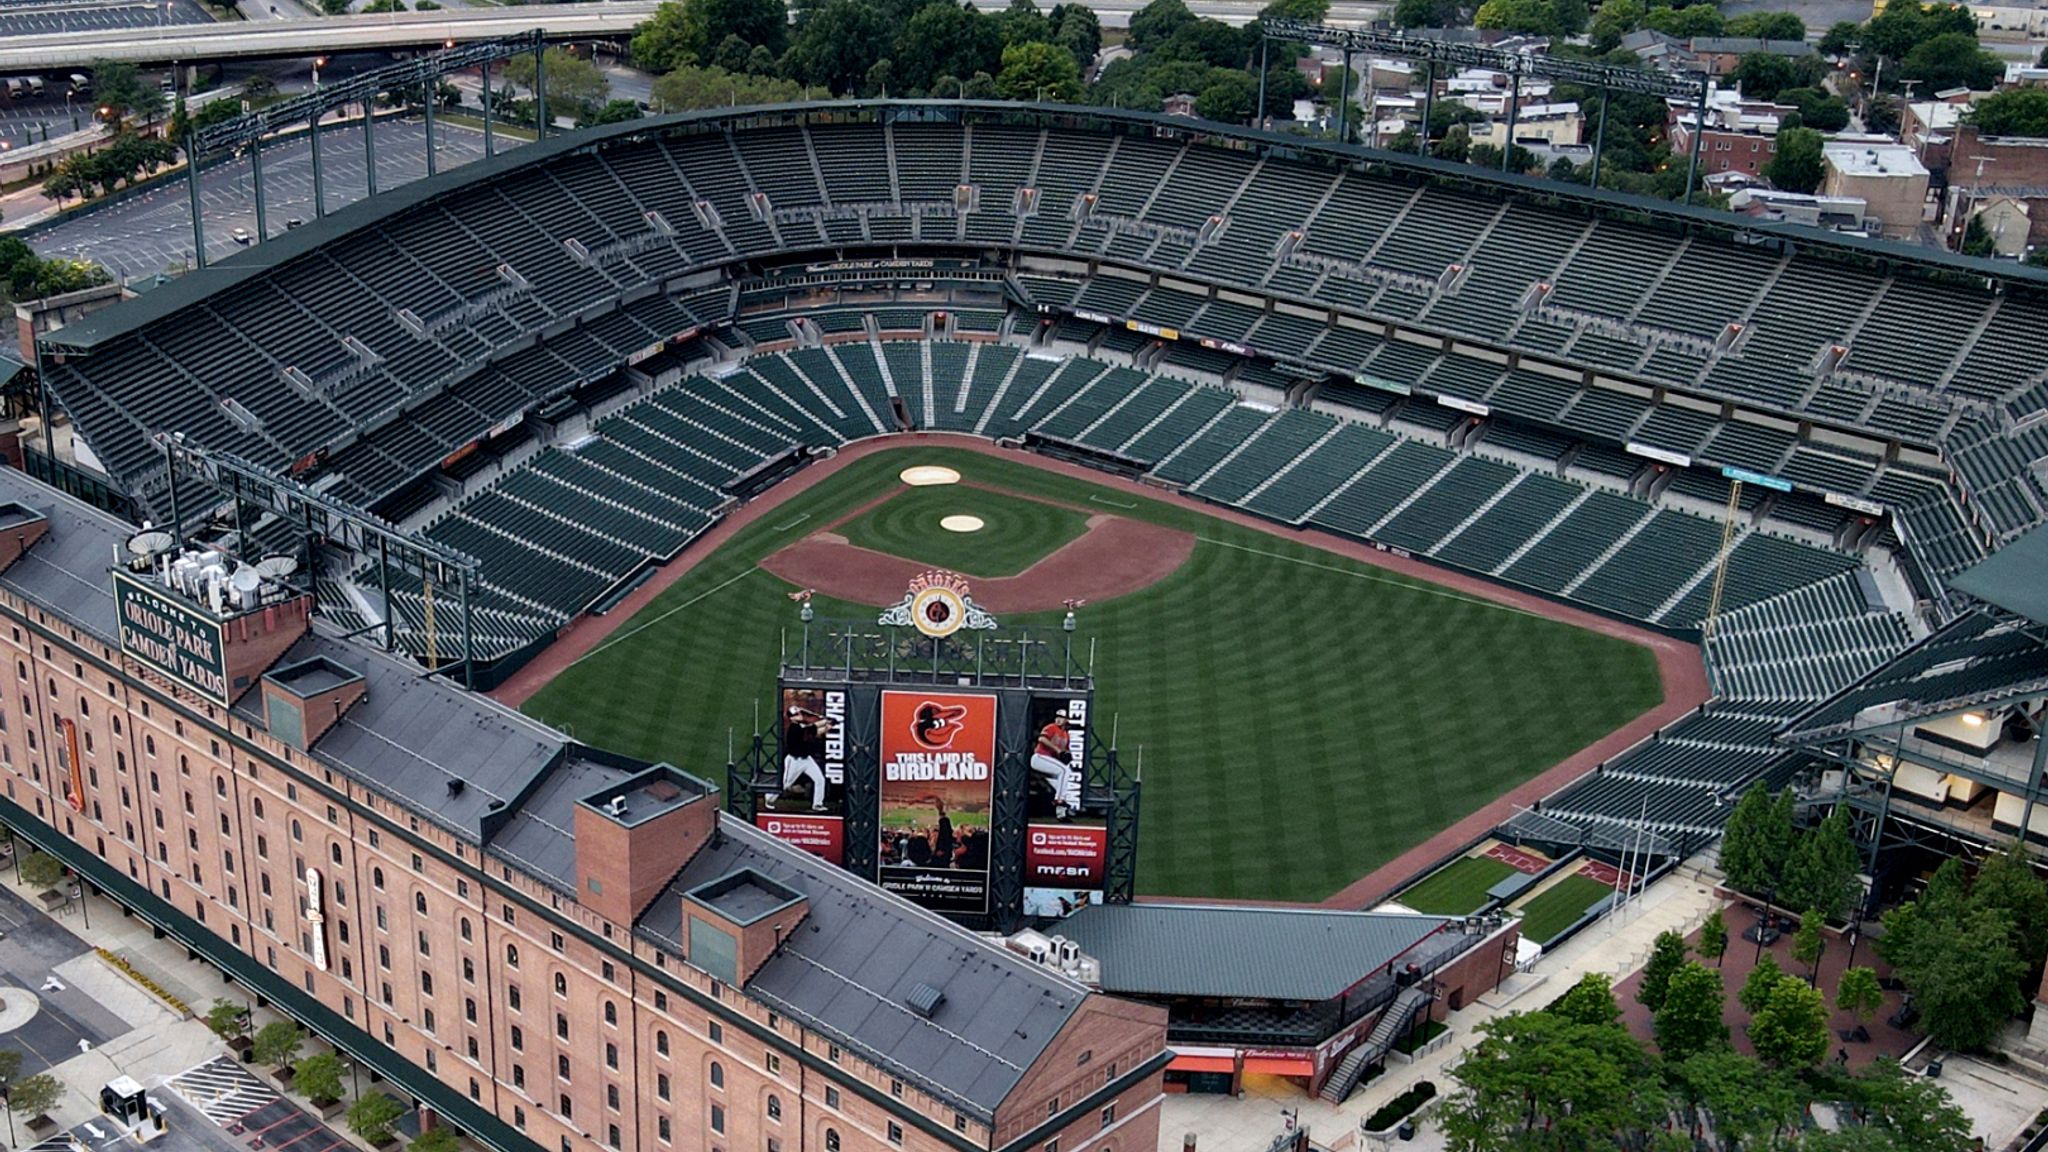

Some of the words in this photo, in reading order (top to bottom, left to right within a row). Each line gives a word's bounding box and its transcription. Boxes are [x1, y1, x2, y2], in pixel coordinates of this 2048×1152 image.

[125, 600, 175, 641] ORIOLE
[175, 625, 215, 665] PARK
[127, 592, 185, 623] WELCOME
[190, 620, 206, 638] TO
[122, 625, 178, 672] CAMDEN
[178, 655, 224, 697] YARDS
[825, 691, 845, 760] CHATTER
[1068, 700, 1086, 727] GET
[825, 762, 844, 784] UP
[886, 762, 988, 781] BIRDLAND
[895, 752, 925, 763] THIS
[926, 752, 960, 763] LAND
[962, 752, 975, 763] IS
